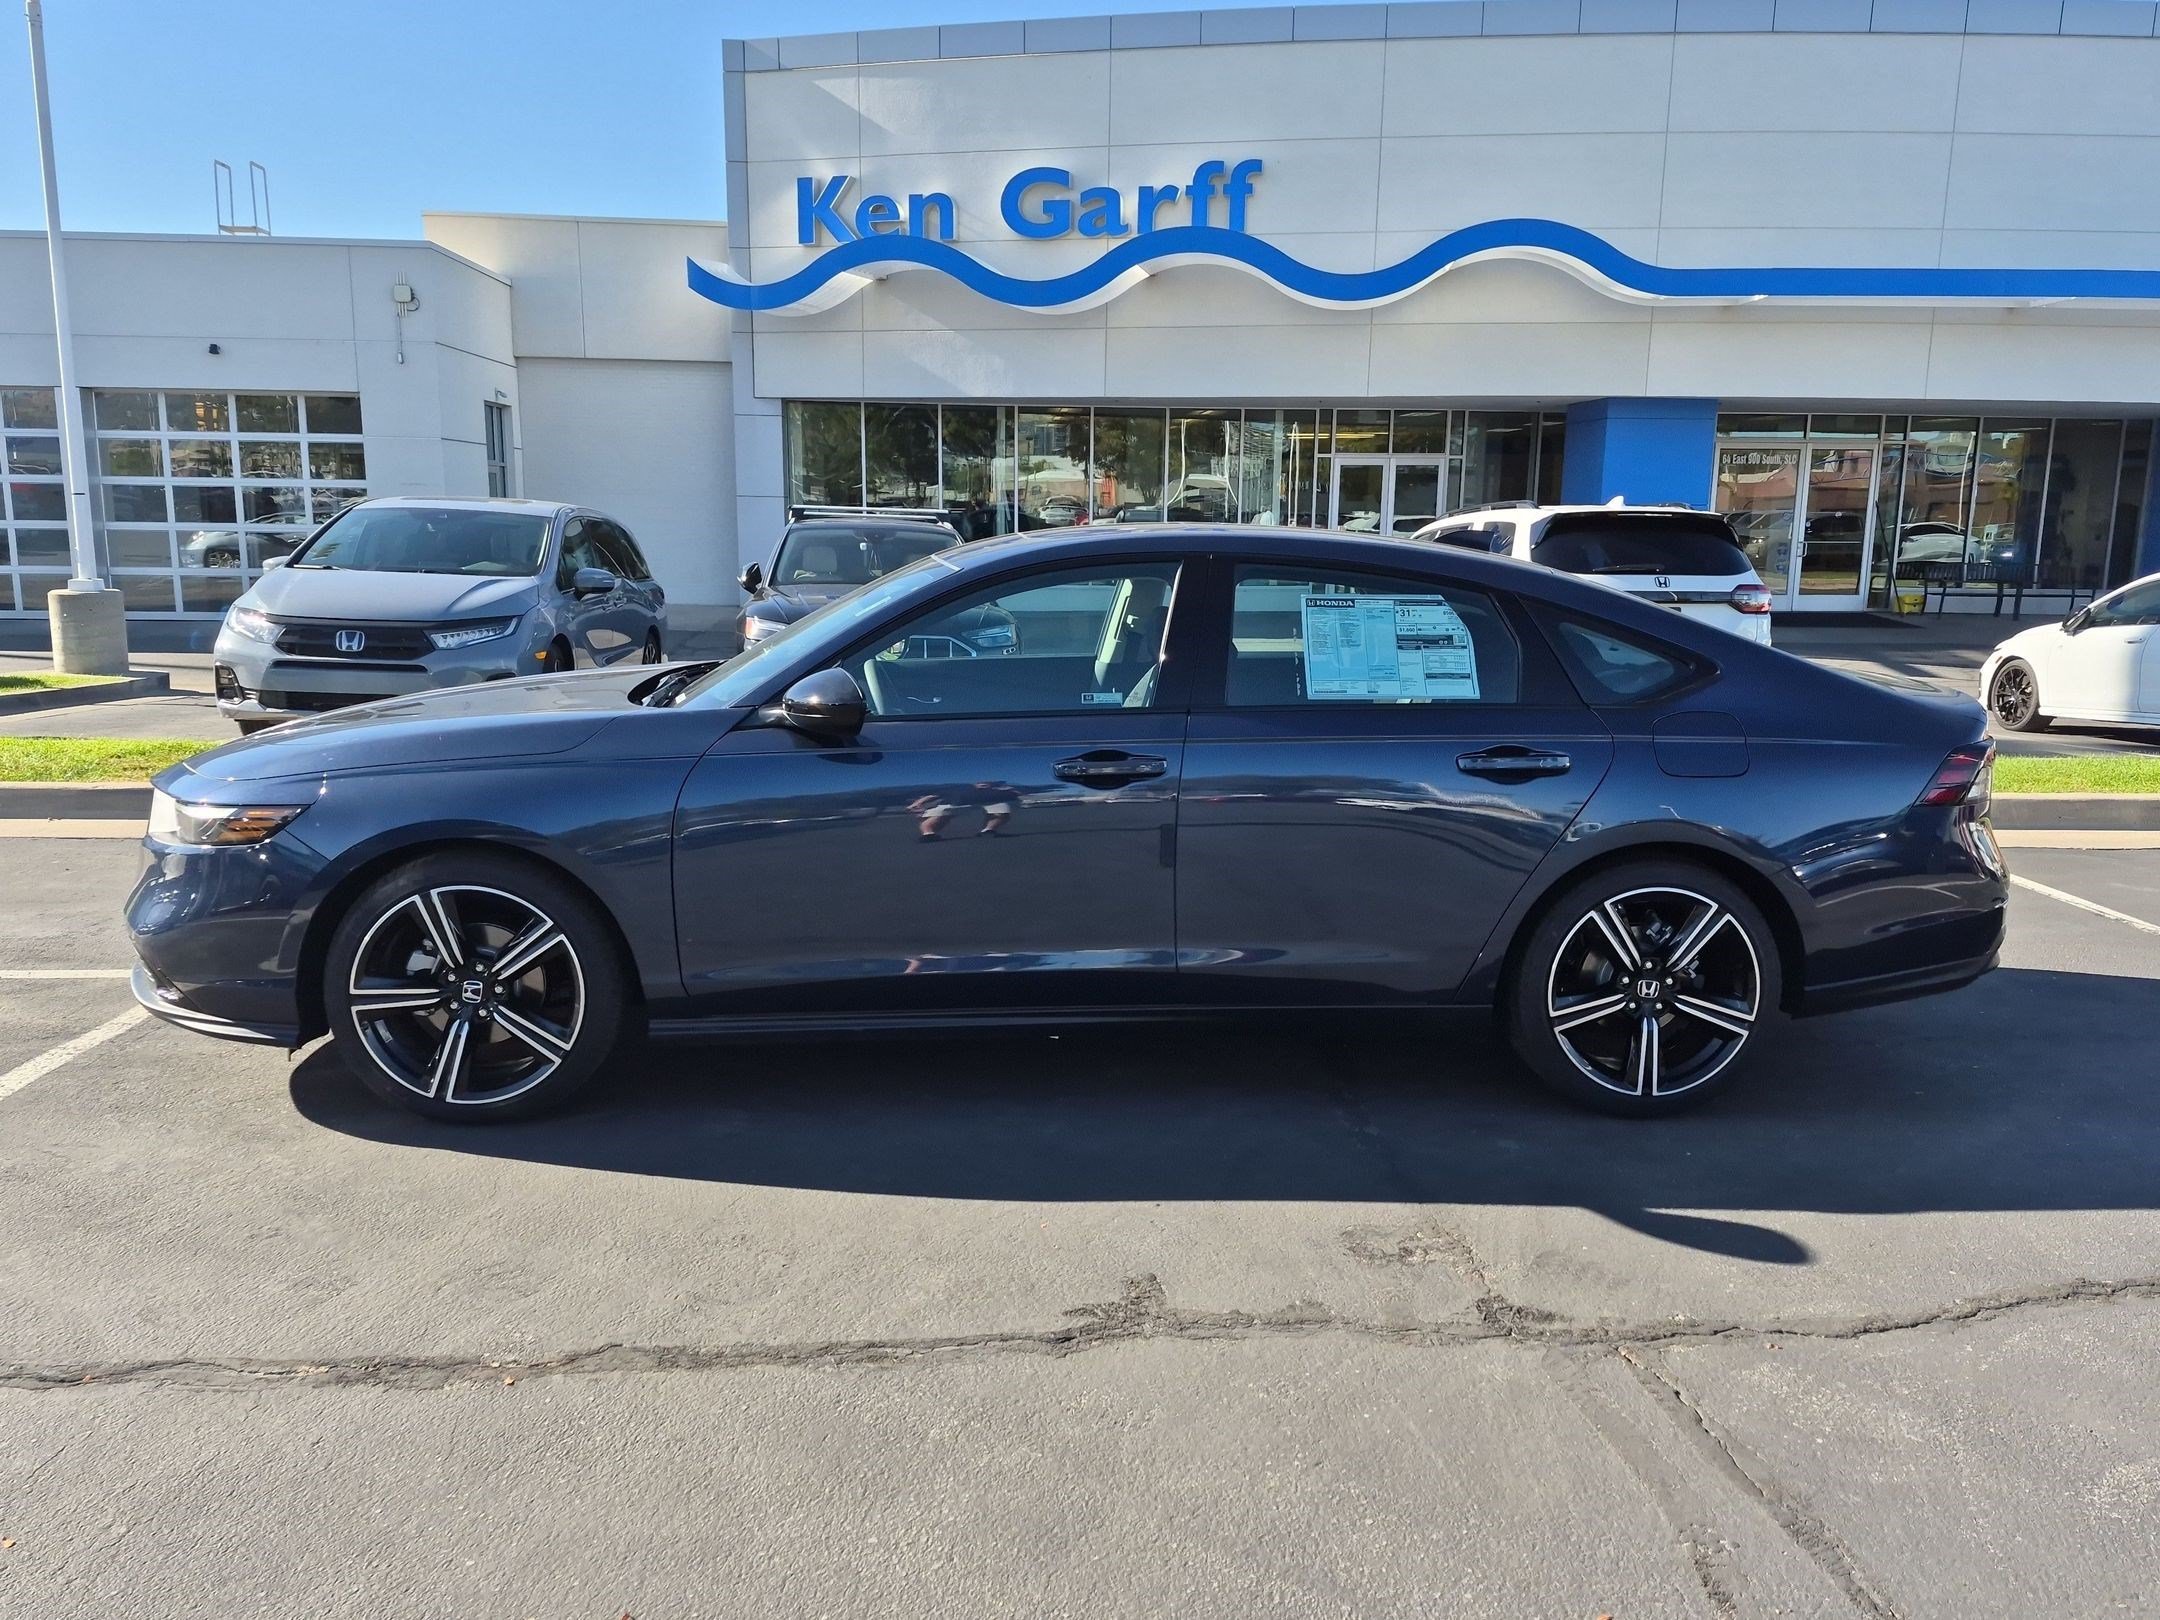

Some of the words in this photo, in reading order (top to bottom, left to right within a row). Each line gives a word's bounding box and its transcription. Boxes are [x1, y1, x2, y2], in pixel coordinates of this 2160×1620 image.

[796, 175, 959, 245] Ken
[1000, 158, 1264, 239] Garff
[1732, 454, 1747, 464] East
[1784, 454, 1797, 464] SLC
[1400, 608, 1411, 617] 31
